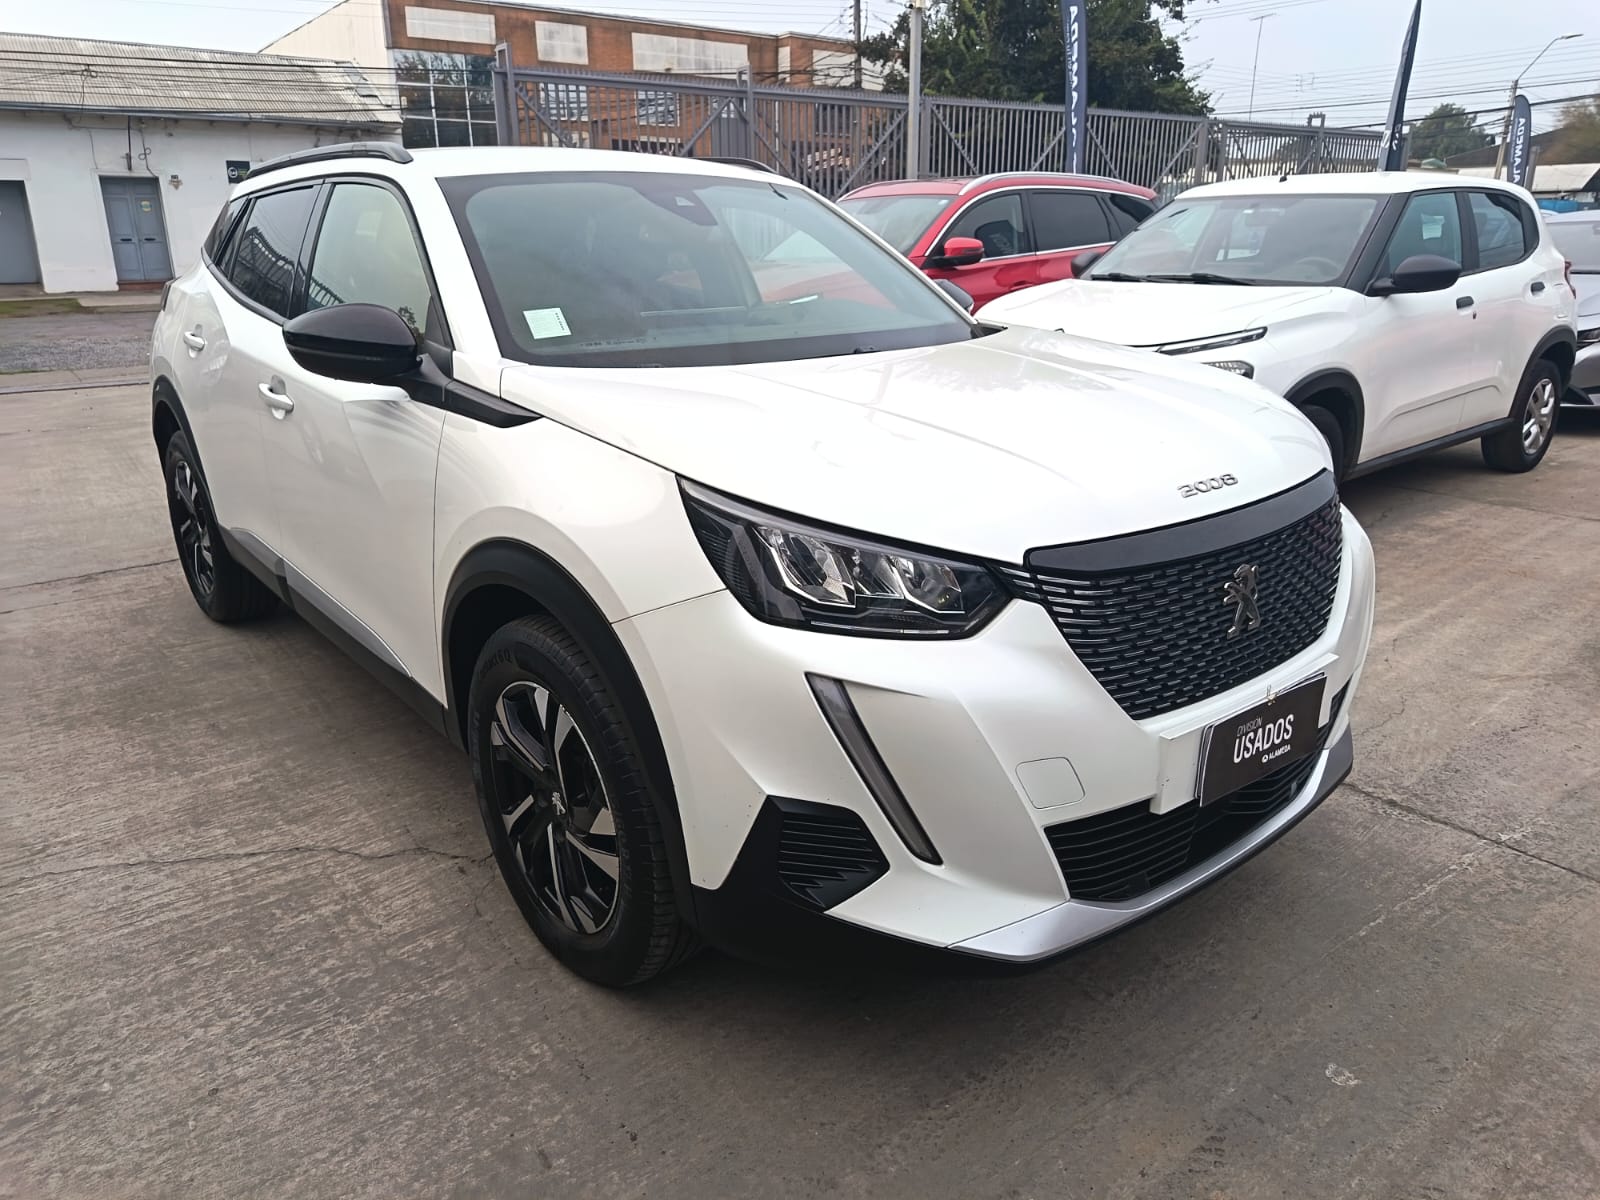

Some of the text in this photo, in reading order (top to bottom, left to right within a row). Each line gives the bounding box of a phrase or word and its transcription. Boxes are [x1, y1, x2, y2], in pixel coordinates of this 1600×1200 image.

[1177, 473, 1239, 498] 2008
[1233, 713, 1294, 764] USADOS
[1269, 744, 1291, 760] ALAMEDA
